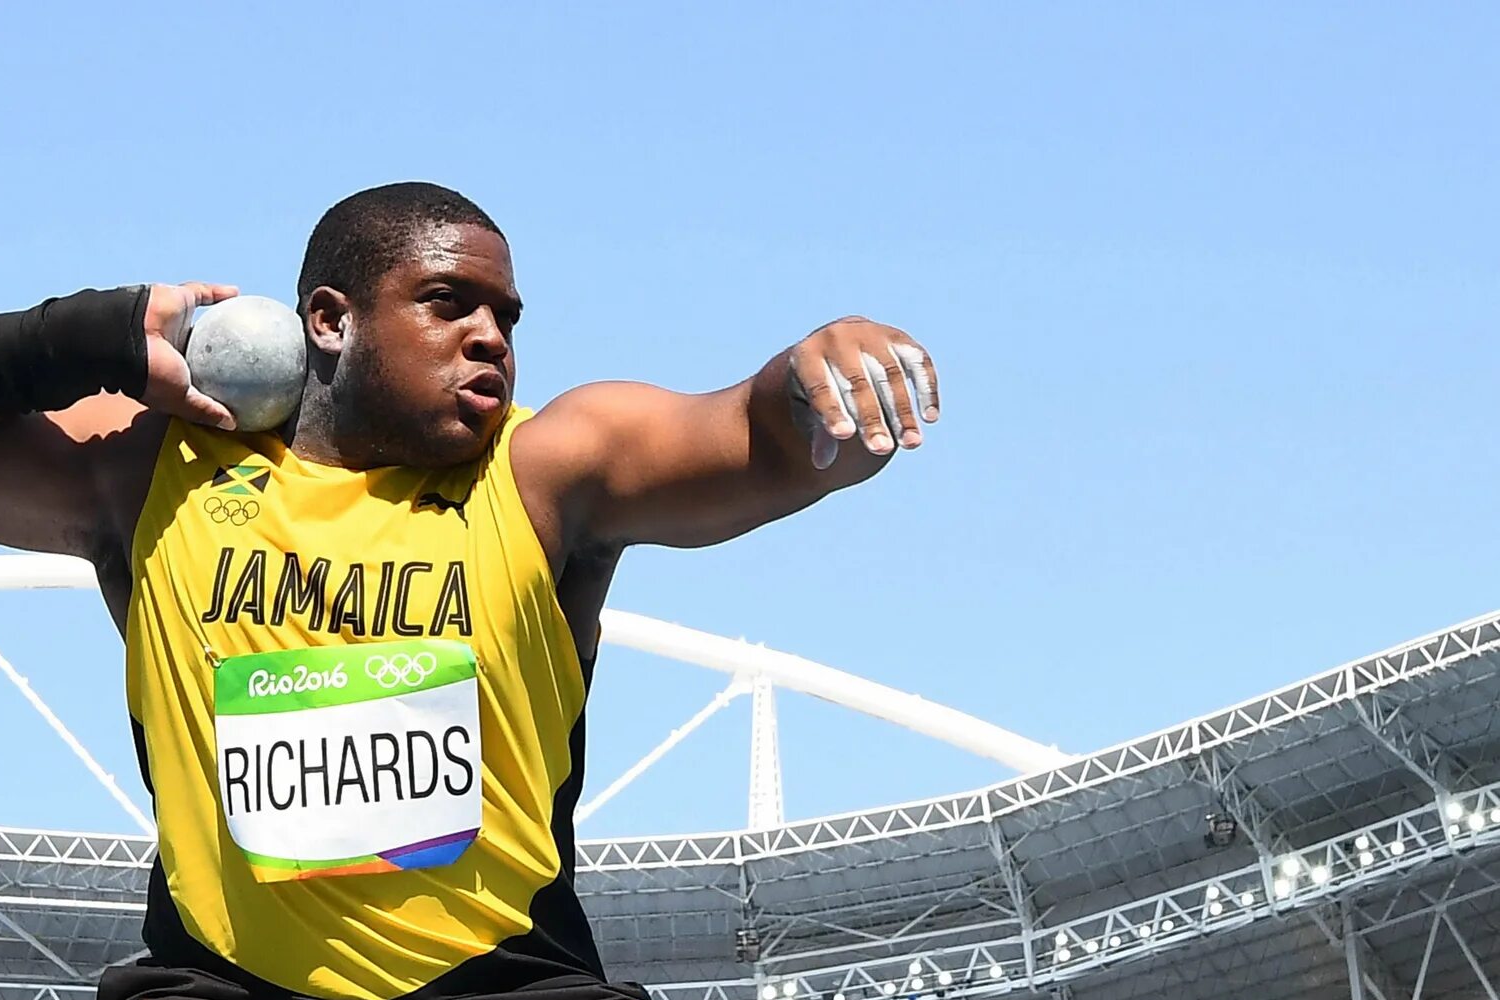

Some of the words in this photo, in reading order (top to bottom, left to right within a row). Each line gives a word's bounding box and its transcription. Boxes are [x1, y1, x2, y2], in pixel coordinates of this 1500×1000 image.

[202, 547, 473, 637] JAMAICA
[249, 662, 348, 698] Rio2016
[223, 725, 475, 817] RICHARDS
